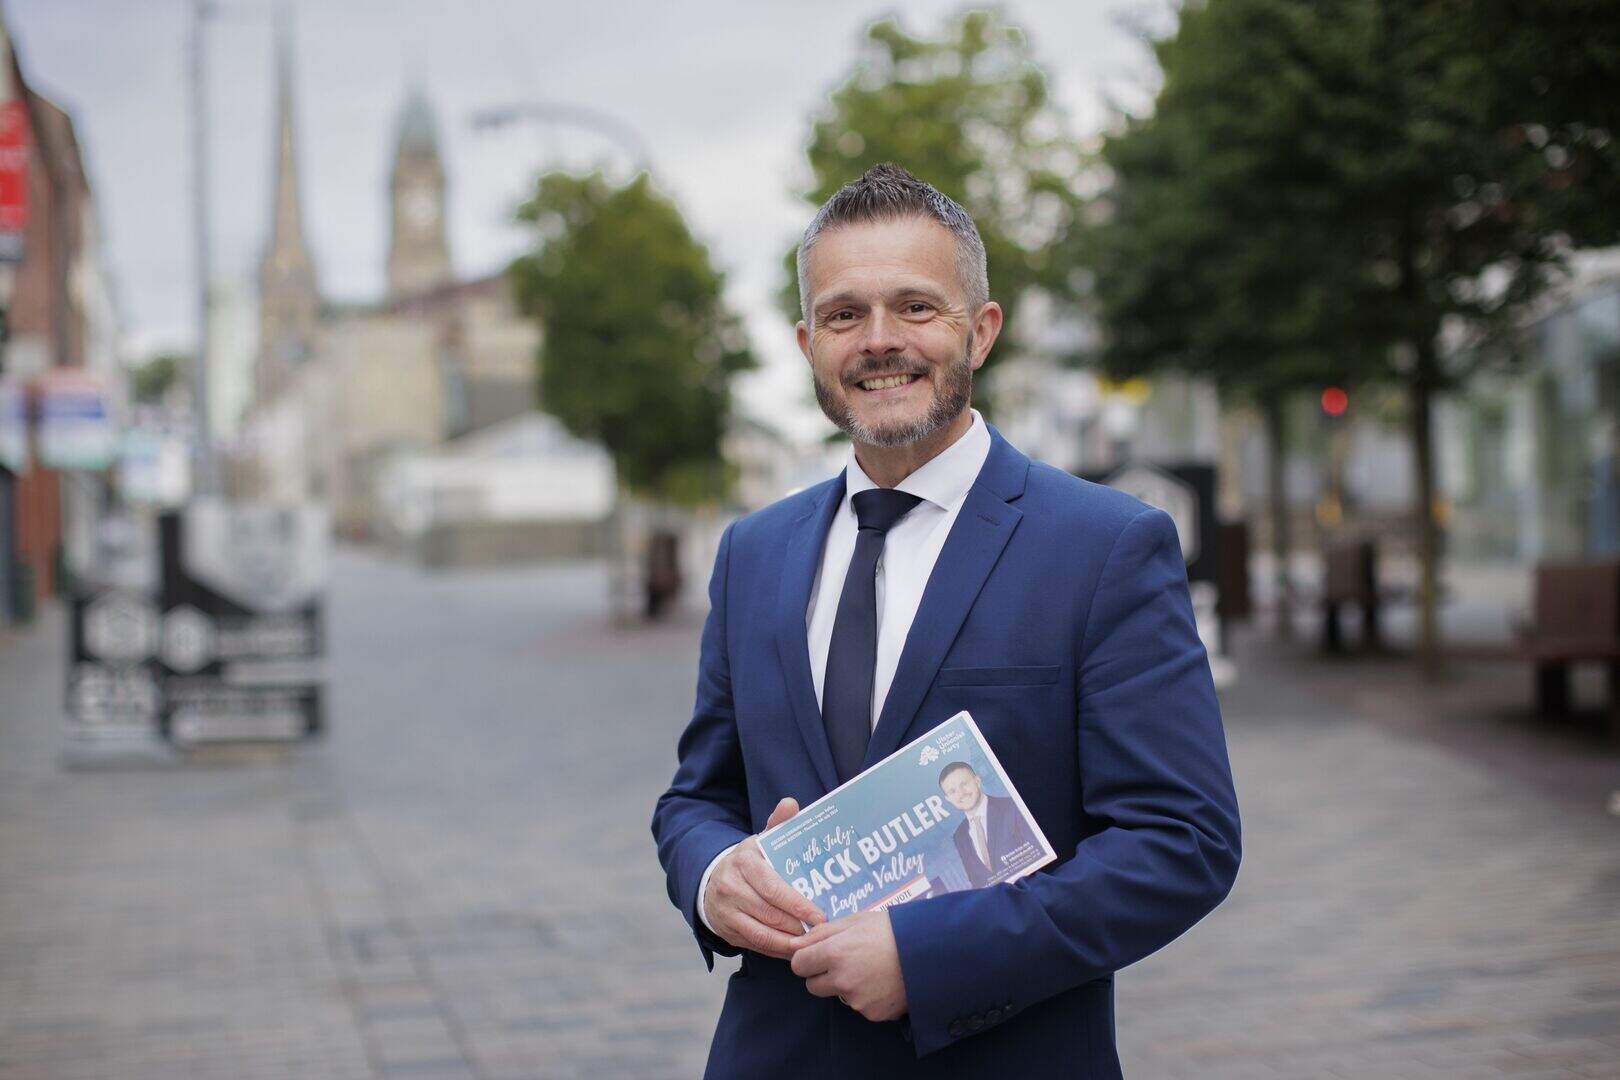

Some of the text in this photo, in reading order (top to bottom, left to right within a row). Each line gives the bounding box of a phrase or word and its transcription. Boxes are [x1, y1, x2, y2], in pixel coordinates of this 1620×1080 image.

[786, 858, 800, 875] On
[803, 838, 821, 864] 4th
[792, 848, 861, 901] BACK
[857, 795, 950, 864] BUTLER
[830, 851, 925, 917] Lagan Valley
